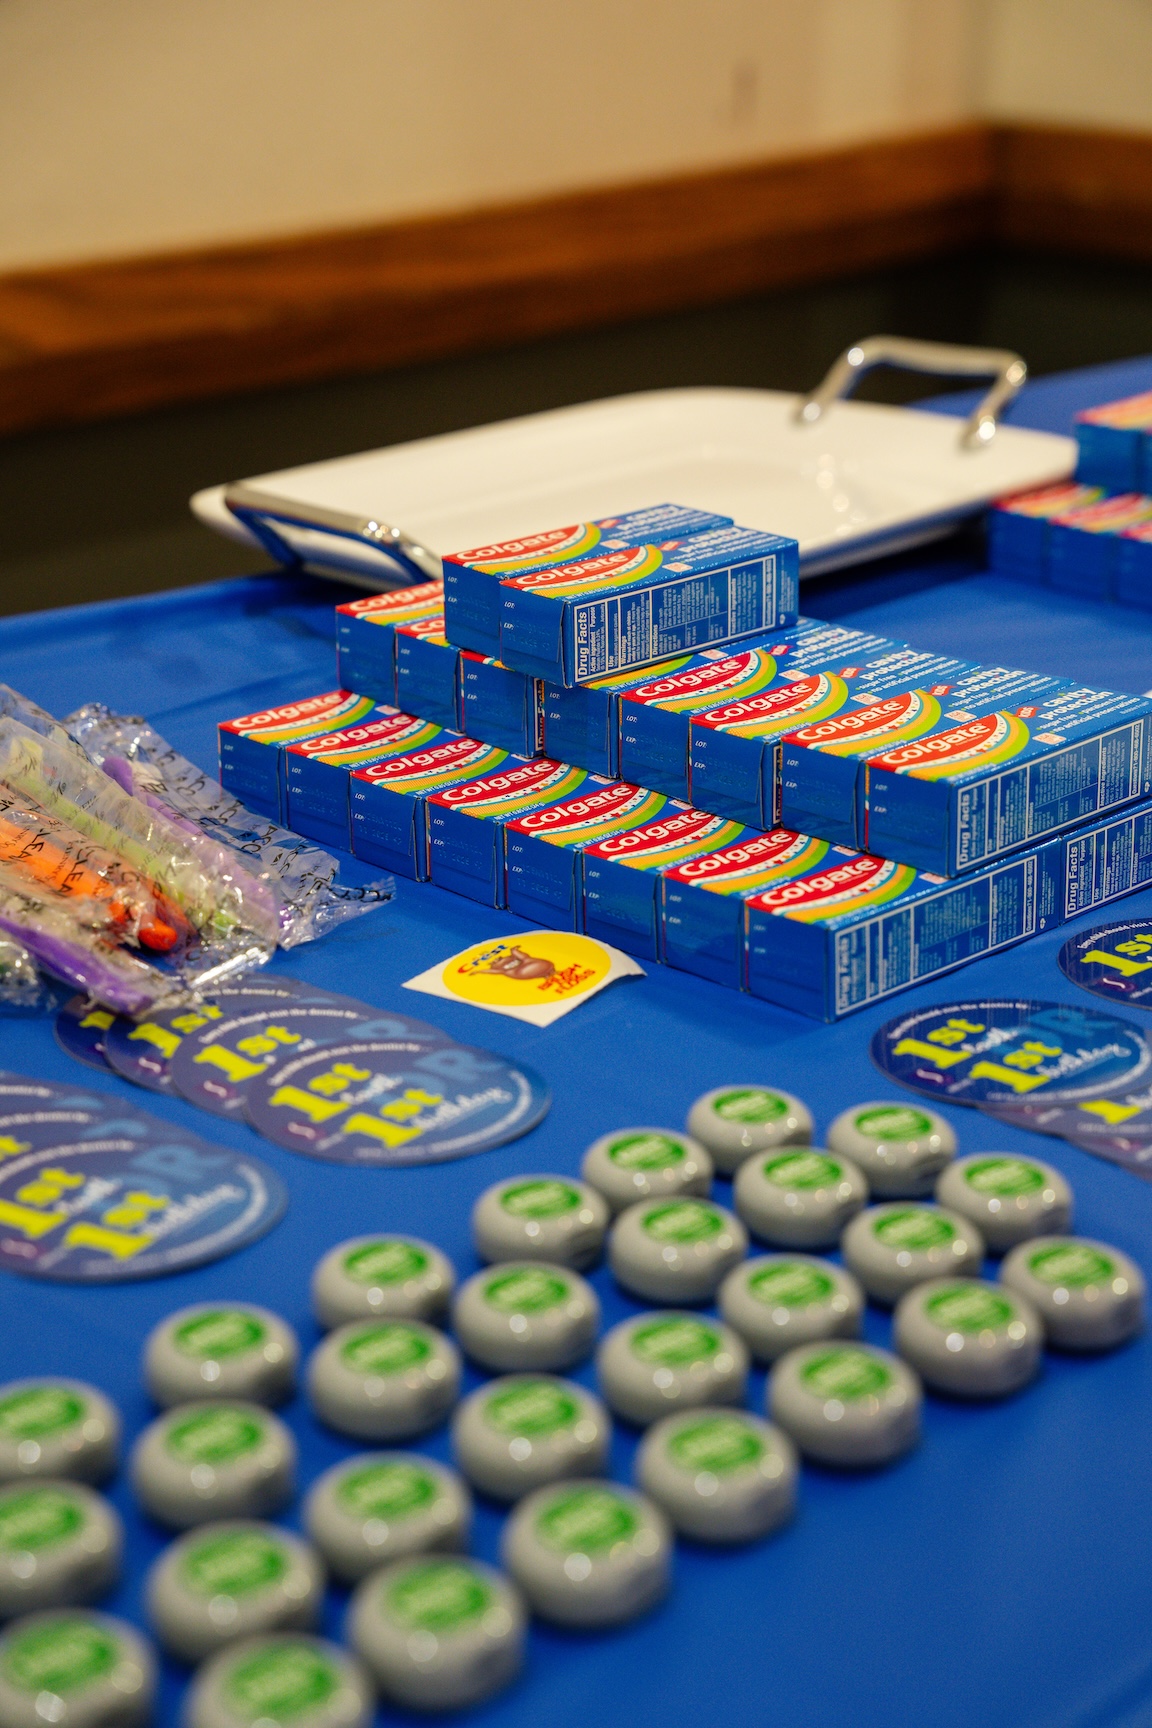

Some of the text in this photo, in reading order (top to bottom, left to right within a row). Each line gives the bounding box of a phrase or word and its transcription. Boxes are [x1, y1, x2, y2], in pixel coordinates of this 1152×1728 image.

[456, 530, 569, 560] Colgate
[515, 553, 629, 585] Colgate
[349, 582, 444, 611] Colgat
[504, 601, 516, 609] LOT:
[503, 622, 515, 630] EXP:
[578, 612, 589, 675] Drug Facts
[635, 659, 741, 697] Colgate
[951, 670, 1027, 698] protection
[956, 667, 1010, 686] cavity
[231, 692, 343, 729] Colgate
[704, 682, 811, 722] Colgate
[1038, 691, 1114, 720] protection
[1042, 687, 1097, 707] cavity
[550, 712, 561, 720] EXP:
[626, 714, 638, 723] LOT:
[796, 701, 904, 742] Colgate
[301, 715, 412, 751] Colgate
[625, 735, 638, 744] EXP:
[695, 740, 708, 749] LOT:
[882, 722, 990, 765] Colgate
[365, 739, 478, 778] Colgate
[694, 761, 707, 770] EXP:
[786, 758, 799, 767] LOT:
[442, 760, 554, 801] Colgate
[785, 781, 798, 790] EXP:
[354, 792, 365, 801] LOT:
[520, 785, 633, 828] Colgate
[354, 812, 365, 821] EXP:
[433, 818, 445, 827] LOT:
[598, 810, 711, 853] Colgate
[960, 794, 971, 862] Drug Facts
[433, 839, 445, 847] EXP:
[512, 845, 523, 853] LOT:
[679, 831, 792, 876] Colgate
[511, 865, 523, 874] EXP:
[761, 859, 878, 905] Colgate
[1068, 847, 1078, 911] Drug Facts
[457, 944, 509, 974] Crest
[192, 1025, 301, 1083] 1st
[893, 1019, 985, 1069] 1st
[969, 1041, 1062, 1094] 1st
[269, 1062, 371, 1123] 1st
[342, 1088, 443, 1148] 1st
[64, 1191, 170, 1262] 1st
